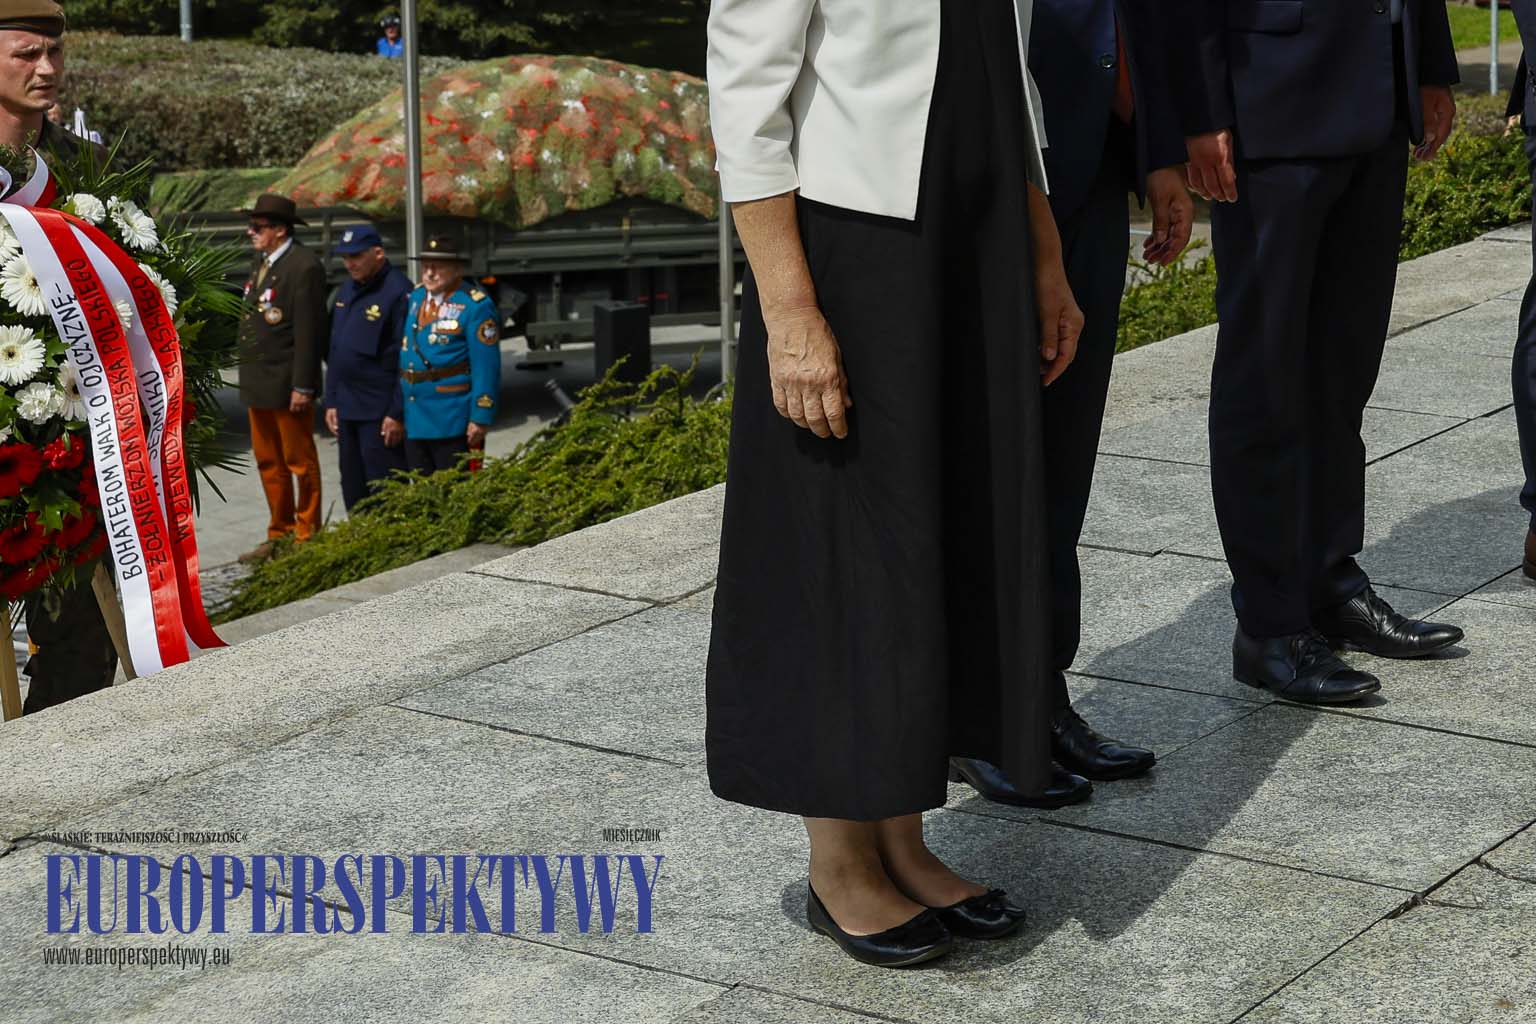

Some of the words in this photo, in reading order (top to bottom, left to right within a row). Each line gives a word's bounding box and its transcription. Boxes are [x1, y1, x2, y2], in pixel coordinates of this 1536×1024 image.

[67, 258, 124, 355] POLSKIEGO
[89, 394, 107, 408] O
[94, 411, 116, 462] WALK
[101, 464, 143, 580] BOHATEROM
